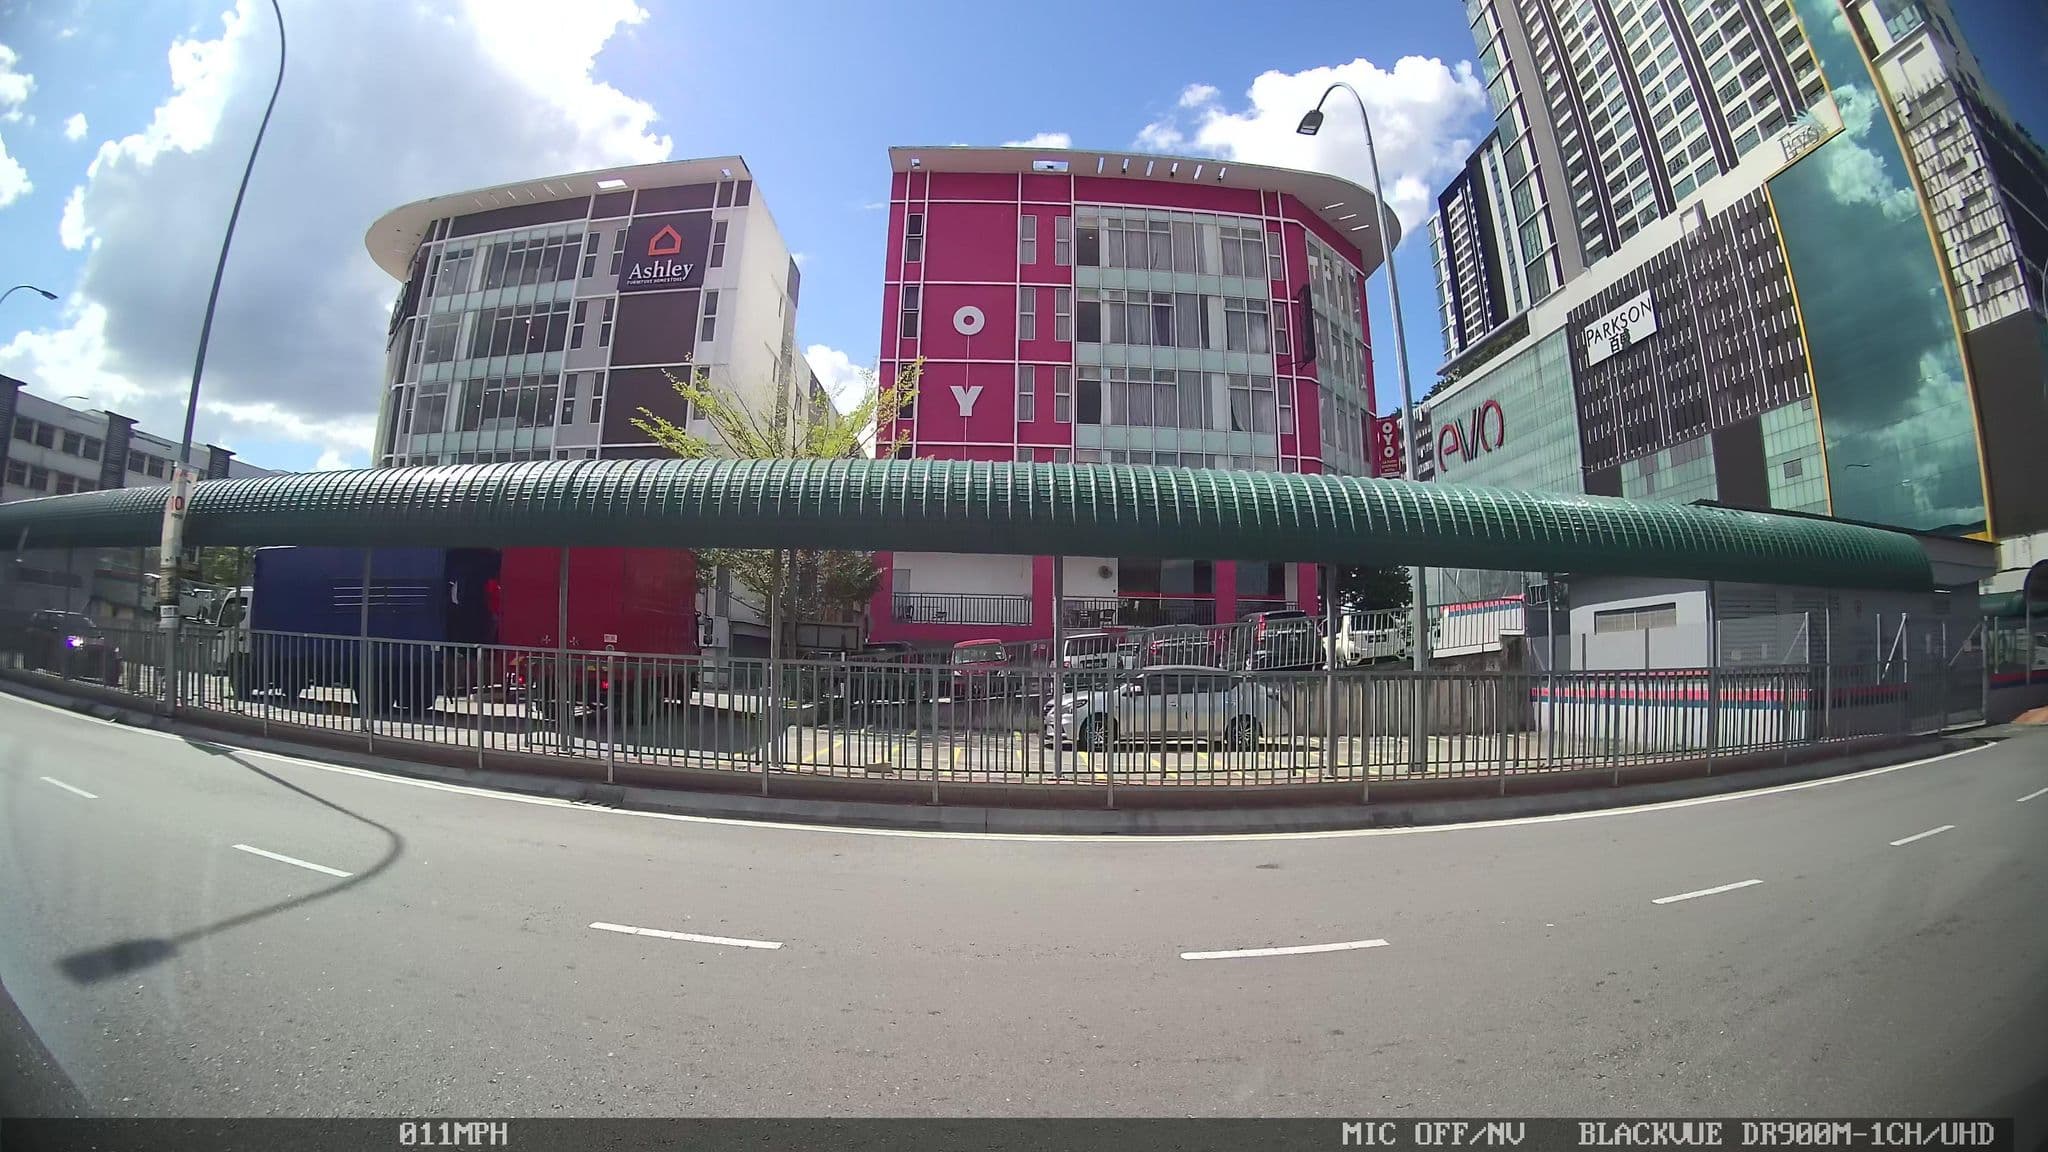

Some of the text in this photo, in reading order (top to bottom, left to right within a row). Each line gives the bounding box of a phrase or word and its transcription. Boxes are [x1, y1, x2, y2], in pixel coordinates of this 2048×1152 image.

[628, 259, 694, 281] Ashley
[1585, 297, 1652, 347] PARKSON
[1382, 422, 1395, 458] OYO
